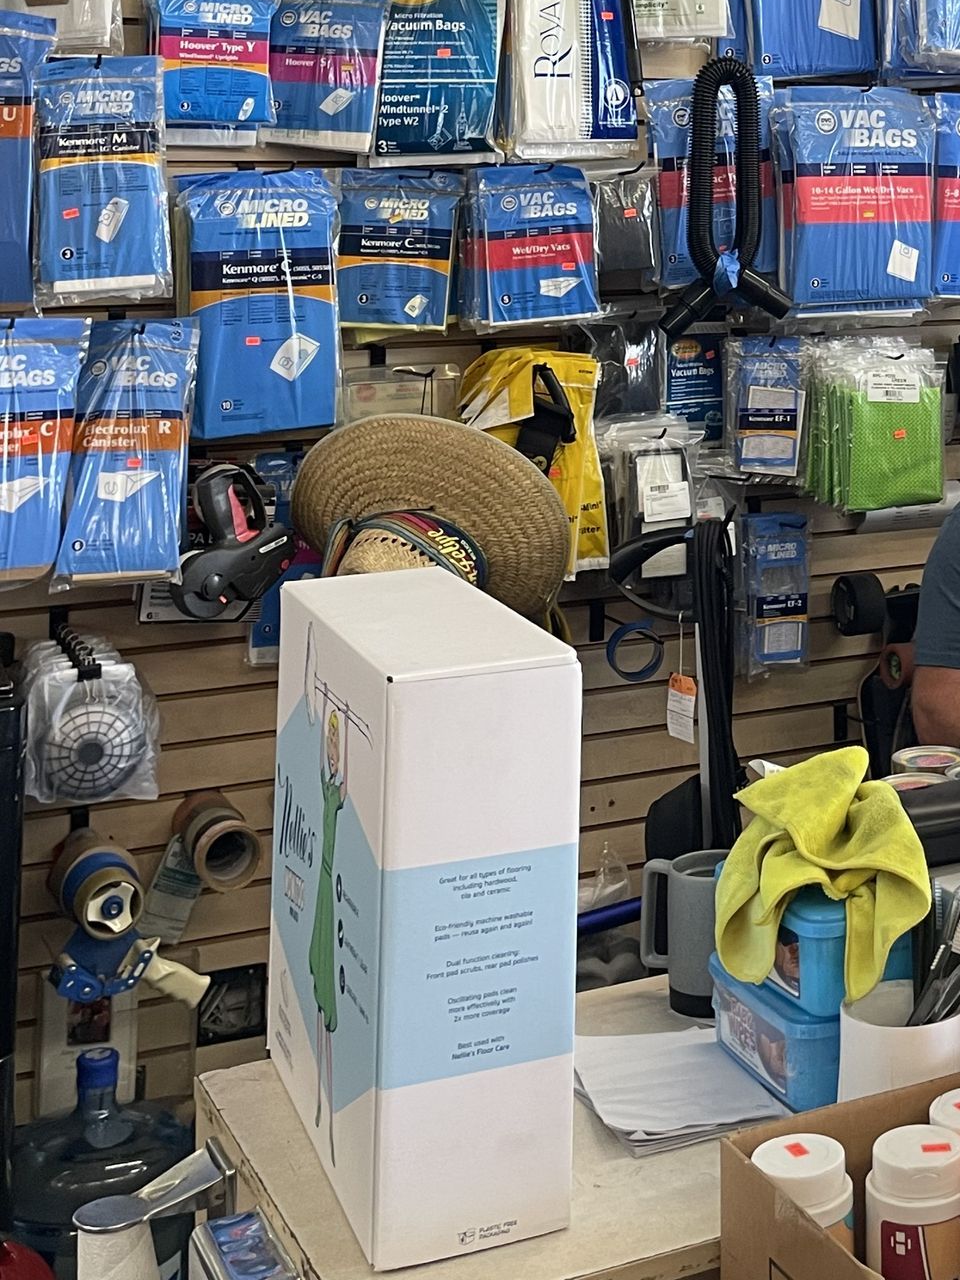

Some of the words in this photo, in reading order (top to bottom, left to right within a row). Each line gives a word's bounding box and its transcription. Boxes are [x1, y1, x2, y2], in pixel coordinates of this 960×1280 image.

[200, 2, 253, 14] MICRO
[205, 14, 253, 25] LINED
[436, 20, 466, 31] Bags
[308, 25, 352, 38] BAGS
[179, 41, 215, 51] Hoover
[222, 43, 244, 52] Type
[246, 41, 255, 52] Y
[77, 90, 135, 103] MICRO
[840, 110, 886, 127] VAC
[59, 137, 106, 147] Kenmore
[112, 134, 127, 144] M
[852, 128, 917, 148] BAGS
[378, 140, 387, 151] 3
[519, 191, 555, 205] VAC
[944, 189, 959, 197] 5-8
[237, 199, 308, 213] MICRO
[379, 198, 429, 209] MICRO
[530, 203, 578, 218] BAGS
[250, 213, 309, 228] LINED
[361, 238, 402, 247] Kenmore
[405, 236, 414, 248] C
[64, 249, 71, 259] 3
[512, 243, 548, 255] Wet/Dry
[550, 242, 571, 252] Vacs
[222, 264, 276, 274] Kenmore
[503, 295, 509, 303] 5
[222, 400, 231, 409] 10
[158, 421, 171, 434] R
[82, 437, 137, 448] Canister
[439, 876, 457, 884] Great
[479, 871, 496, 879] types
[507, 865, 531, 873] flooring
[426, 972, 444, 980] Front
[499, 960, 511, 968] pad
[513, 956, 538, 965] polishes
[448, 993, 481, 1004] Oscillating
[483, 990, 498, 999] pads
[500, 987, 517, 995] clean
[474, 1039, 489, 1047] used
[491, 1035, 504, 1043] with
[477, 1047, 493, 1055] Floor
[495, 1044, 510, 1052] Care
